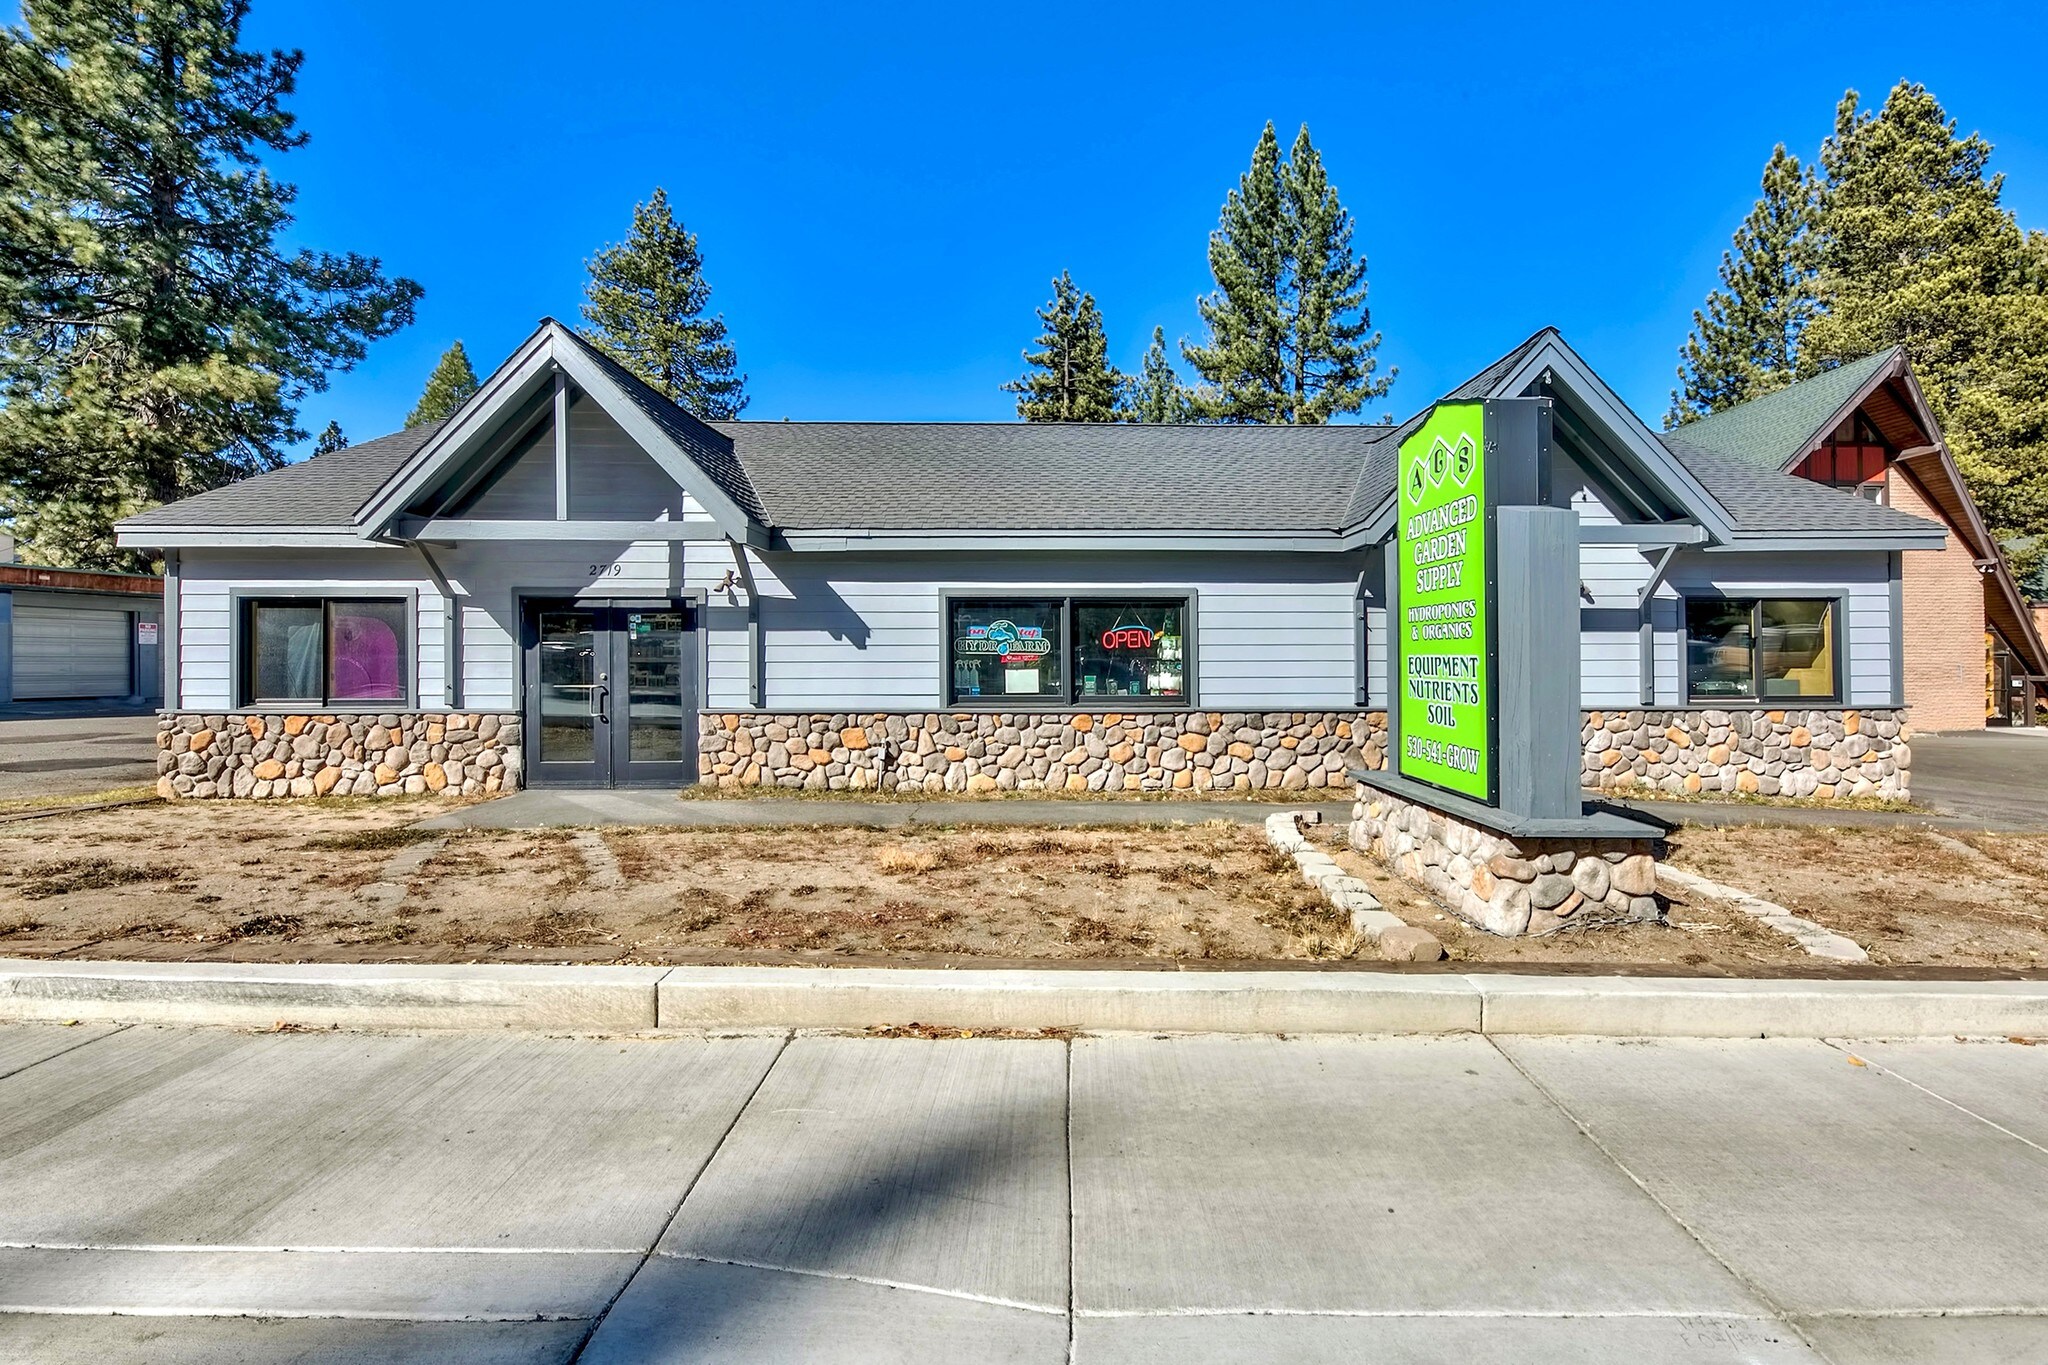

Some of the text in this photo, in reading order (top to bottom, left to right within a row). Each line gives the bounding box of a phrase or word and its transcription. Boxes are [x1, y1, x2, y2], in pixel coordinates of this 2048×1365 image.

[1406, 494, 1478, 541] ADVANCED
[1413, 528, 1467, 566] GARDEN
[588, 563, 622, 577] 2719
[1416, 559, 1464, 594] SUPPLY
[1407, 600, 1477, 624] HYDROPONICS
[1102, 630, 1151, 649] OPEN
[1411, 621, 1473, 641] & ORGANICS
[1408, 656, 1479, 679] EQUIPMENT
[1408, 679, 1479, 705] NUTRIENTS
[1427, 704, 1456, 728] SOIL
[1407, 735, 1480, 775] 530-541-GROW
